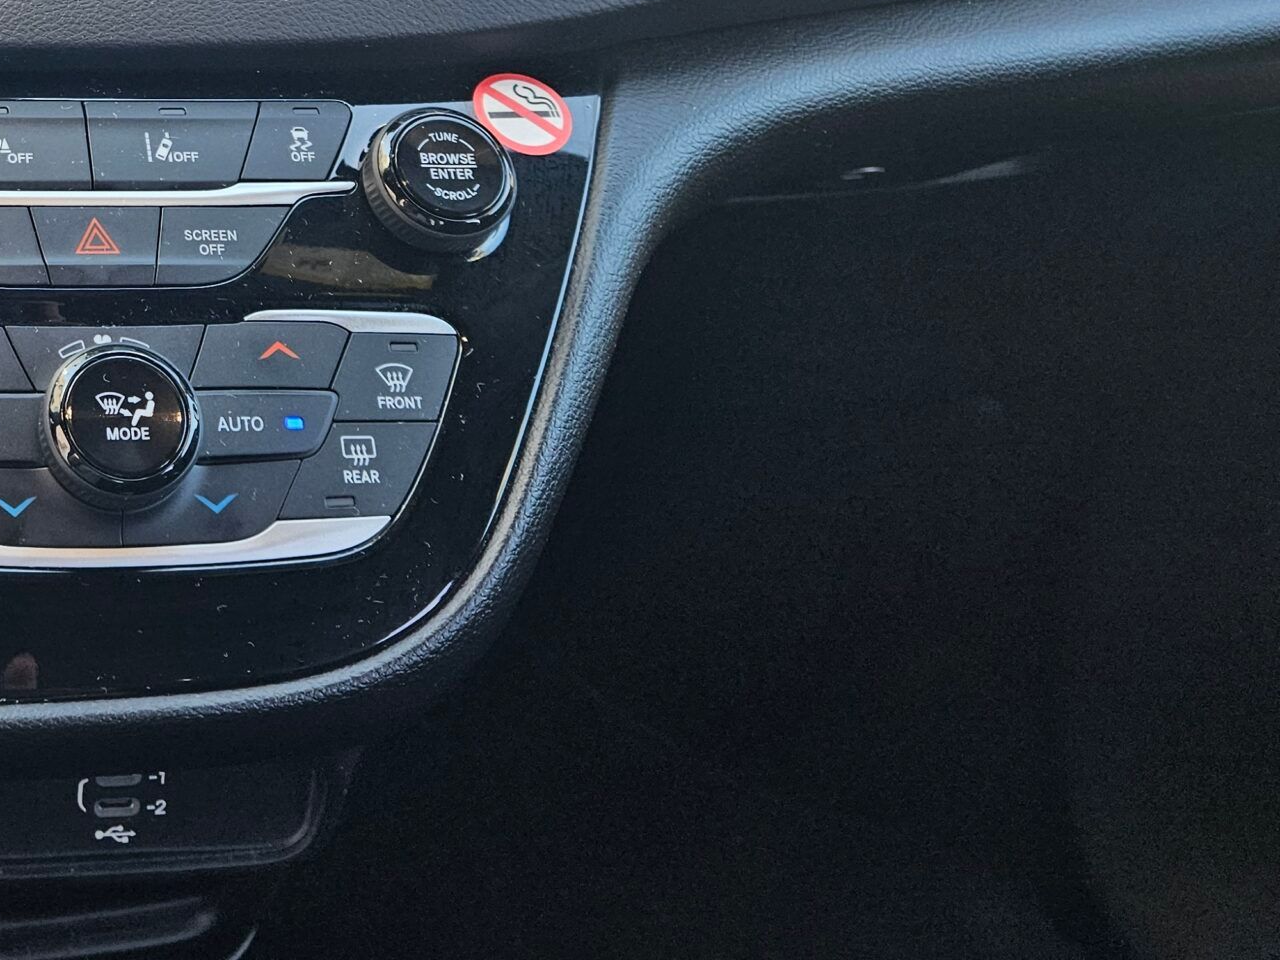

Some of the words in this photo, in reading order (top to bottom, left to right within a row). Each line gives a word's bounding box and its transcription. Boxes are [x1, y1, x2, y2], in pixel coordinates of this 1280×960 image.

[428, 131, 459, 144] TUNE
[7, 152, 34, 165] OFF
[173, 151, 199, 163] OFF
[290, 151, 315, 162] OFF
[420, 152, 476, 165] BROWSE
[430, 168, 475, 180] ENTER
[433, 186, 478, 201] SCROLL
[184, 229, 237, 242] SCREEN
[199, 243, 225, 256] OFF
[377, 395, 423, 410] FRONT
[217, 415, 264, 433] AUTO
[106, 426, 151, 441] MODE
[343, 469, 381, 484] REAR
